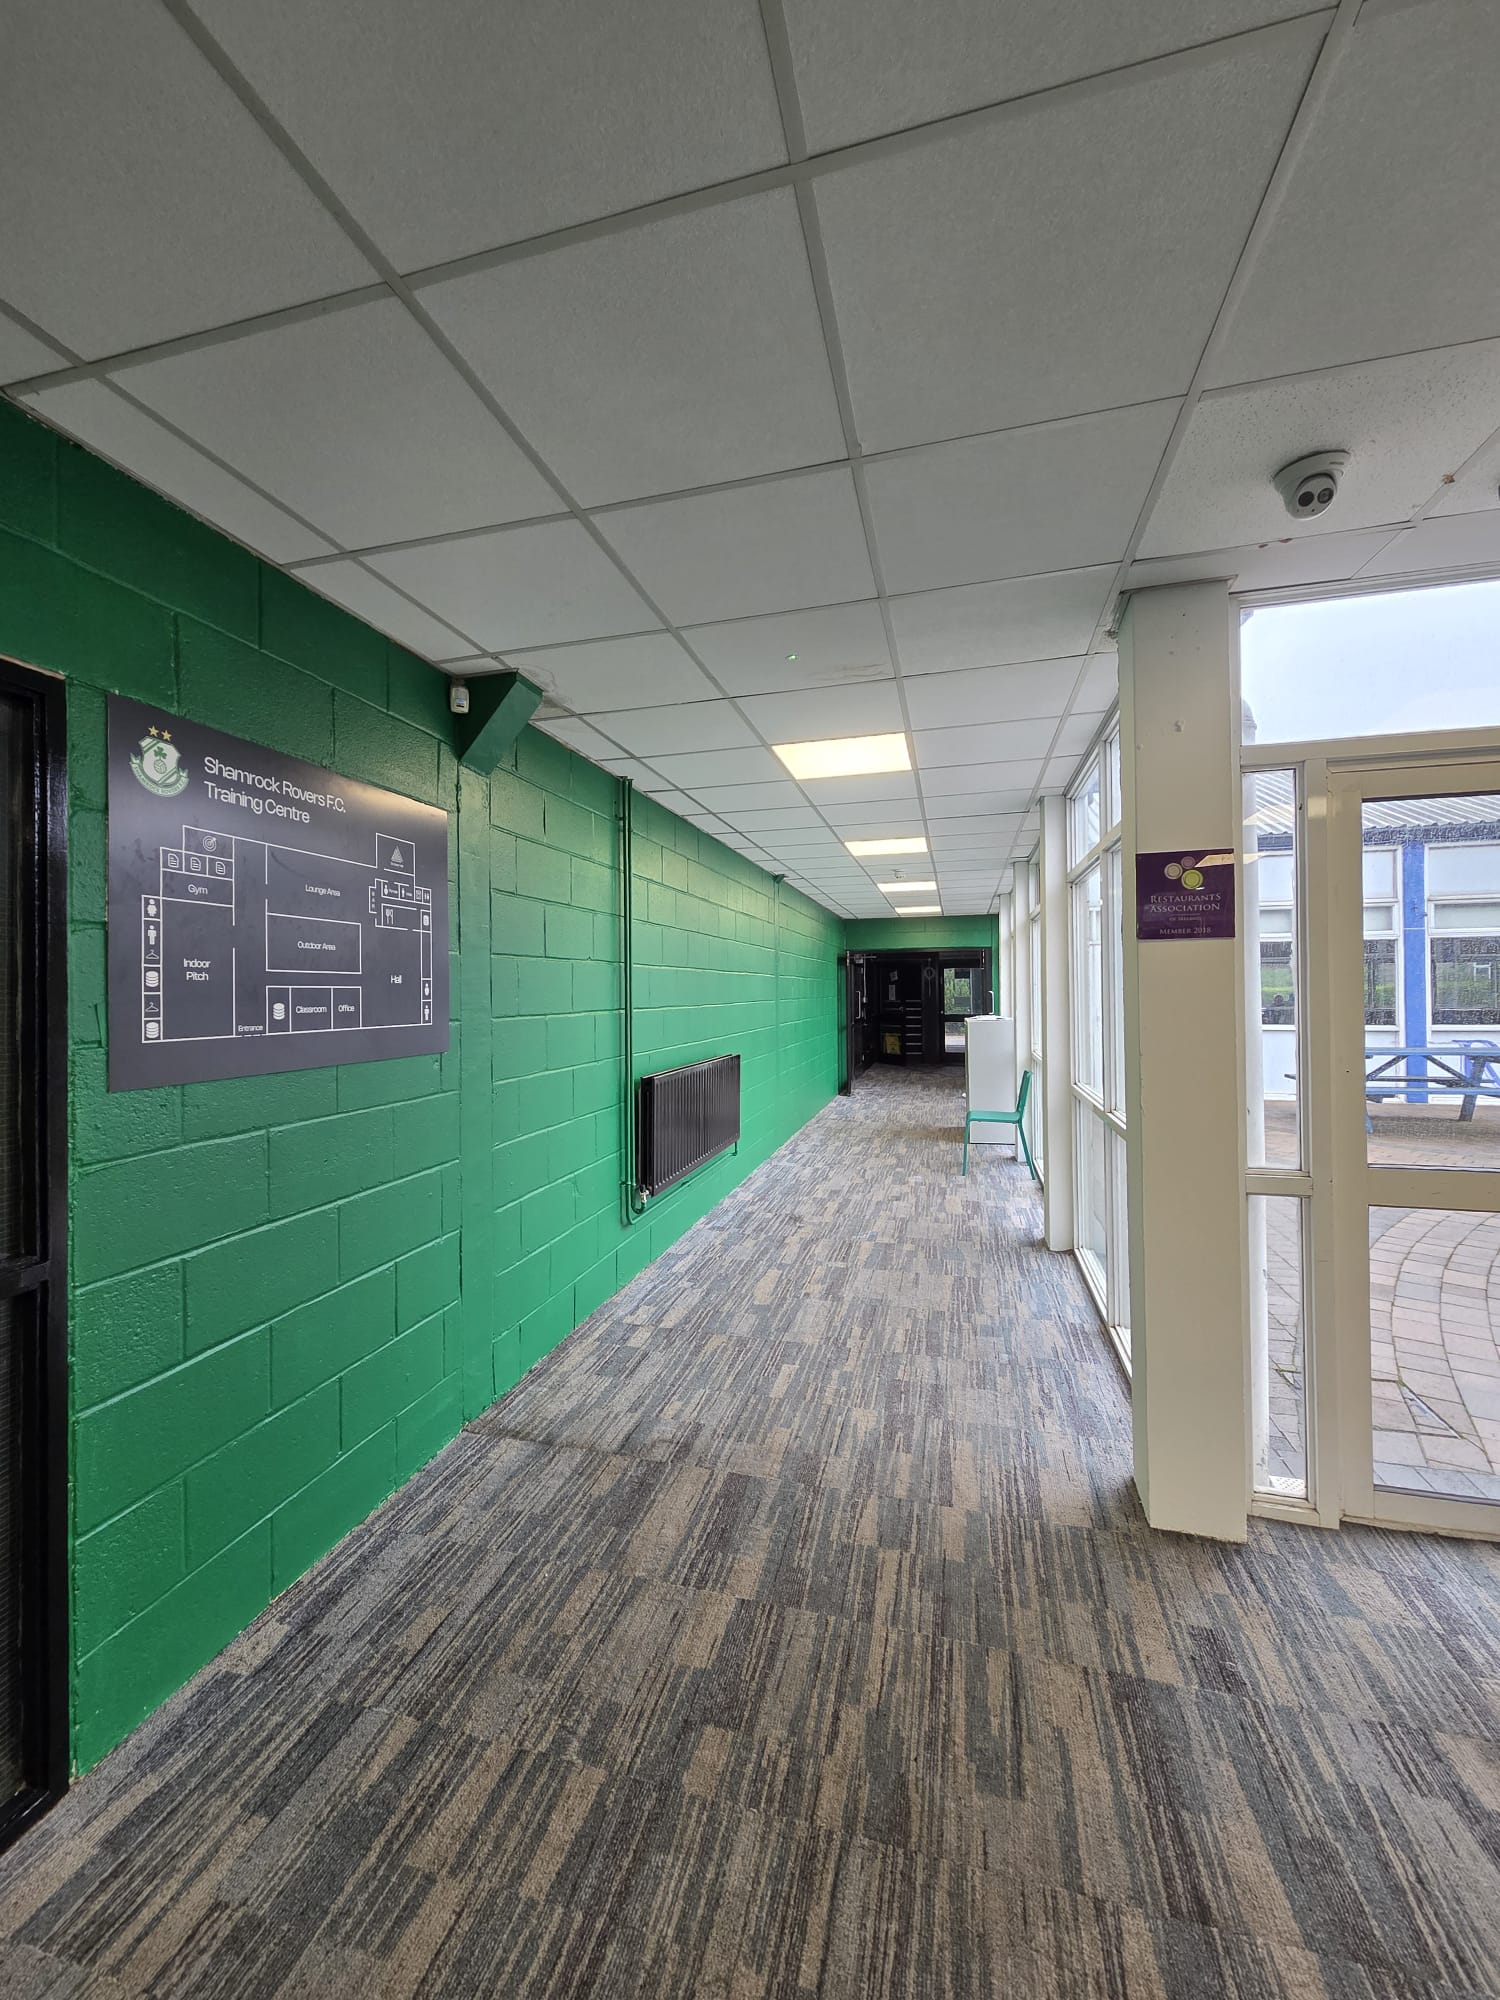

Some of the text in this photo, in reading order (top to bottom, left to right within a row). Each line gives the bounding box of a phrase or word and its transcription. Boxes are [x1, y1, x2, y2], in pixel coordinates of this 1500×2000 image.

[204, 756, 280, 794] Shamrock
[283, 781, 325, 807] Rovers
[327, 795, 346, 813] F.C.
[204, 781, 310, 823] Training Centre
[187, 884, 208, 896] Gym
[305, 884, 341, 897] Lounge Area
[1150, 893, 1222, 903] RESTAURANTS
[1150, 903, 1220, 913] ASSOCIATION
[297, 941, 336, 951] Outdoor Area
[183, 958, 211, 969] Indoor
[186, 971, 209, 981] Pitch
[390, 975, 402, 984] Hall
[295, 1003, 355, 1015] Classroom Office
[238, 1024, 264, 1032] Entrance
